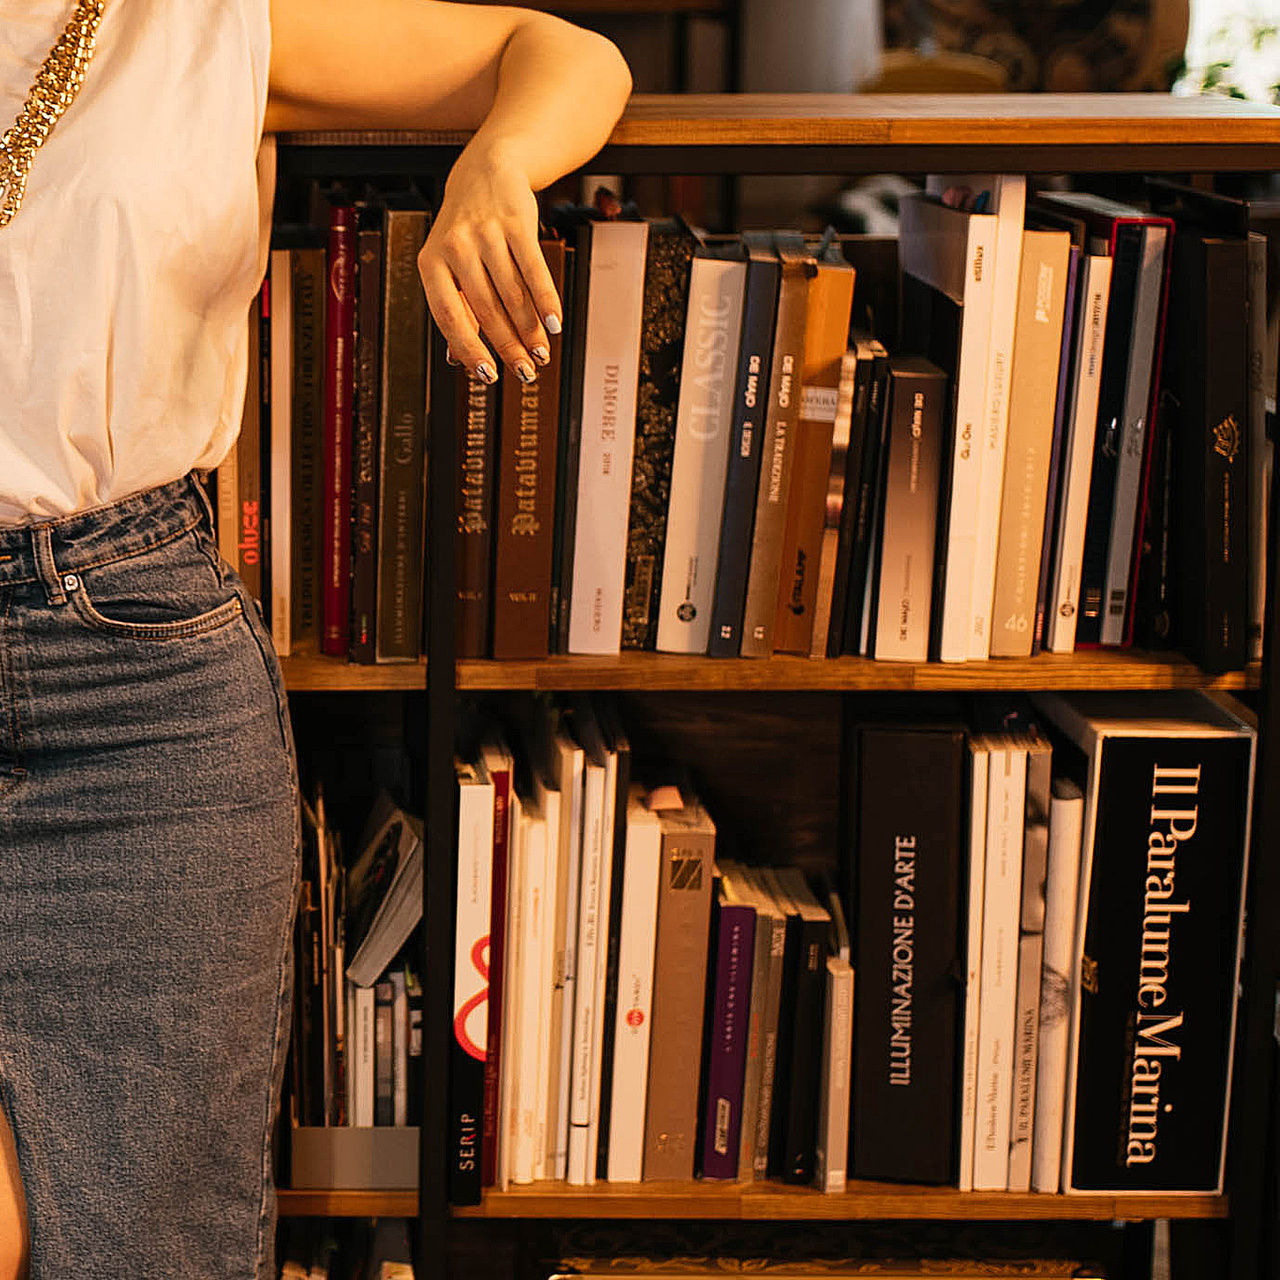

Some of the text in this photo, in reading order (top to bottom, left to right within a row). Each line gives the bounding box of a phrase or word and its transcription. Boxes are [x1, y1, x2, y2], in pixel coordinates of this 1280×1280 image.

[601, 363, 620, 440] DIMORE
[689, 295, 732, 441] CLASSIC
[393, 411, 416, 467] Gallo
[889, 835, 917, 1086] ILLUMINAZIONE D'ARTE
[1125, 762, 1202, 1168] Il Paralume Marina
[458, 1112, 479, 1172] SERIP
